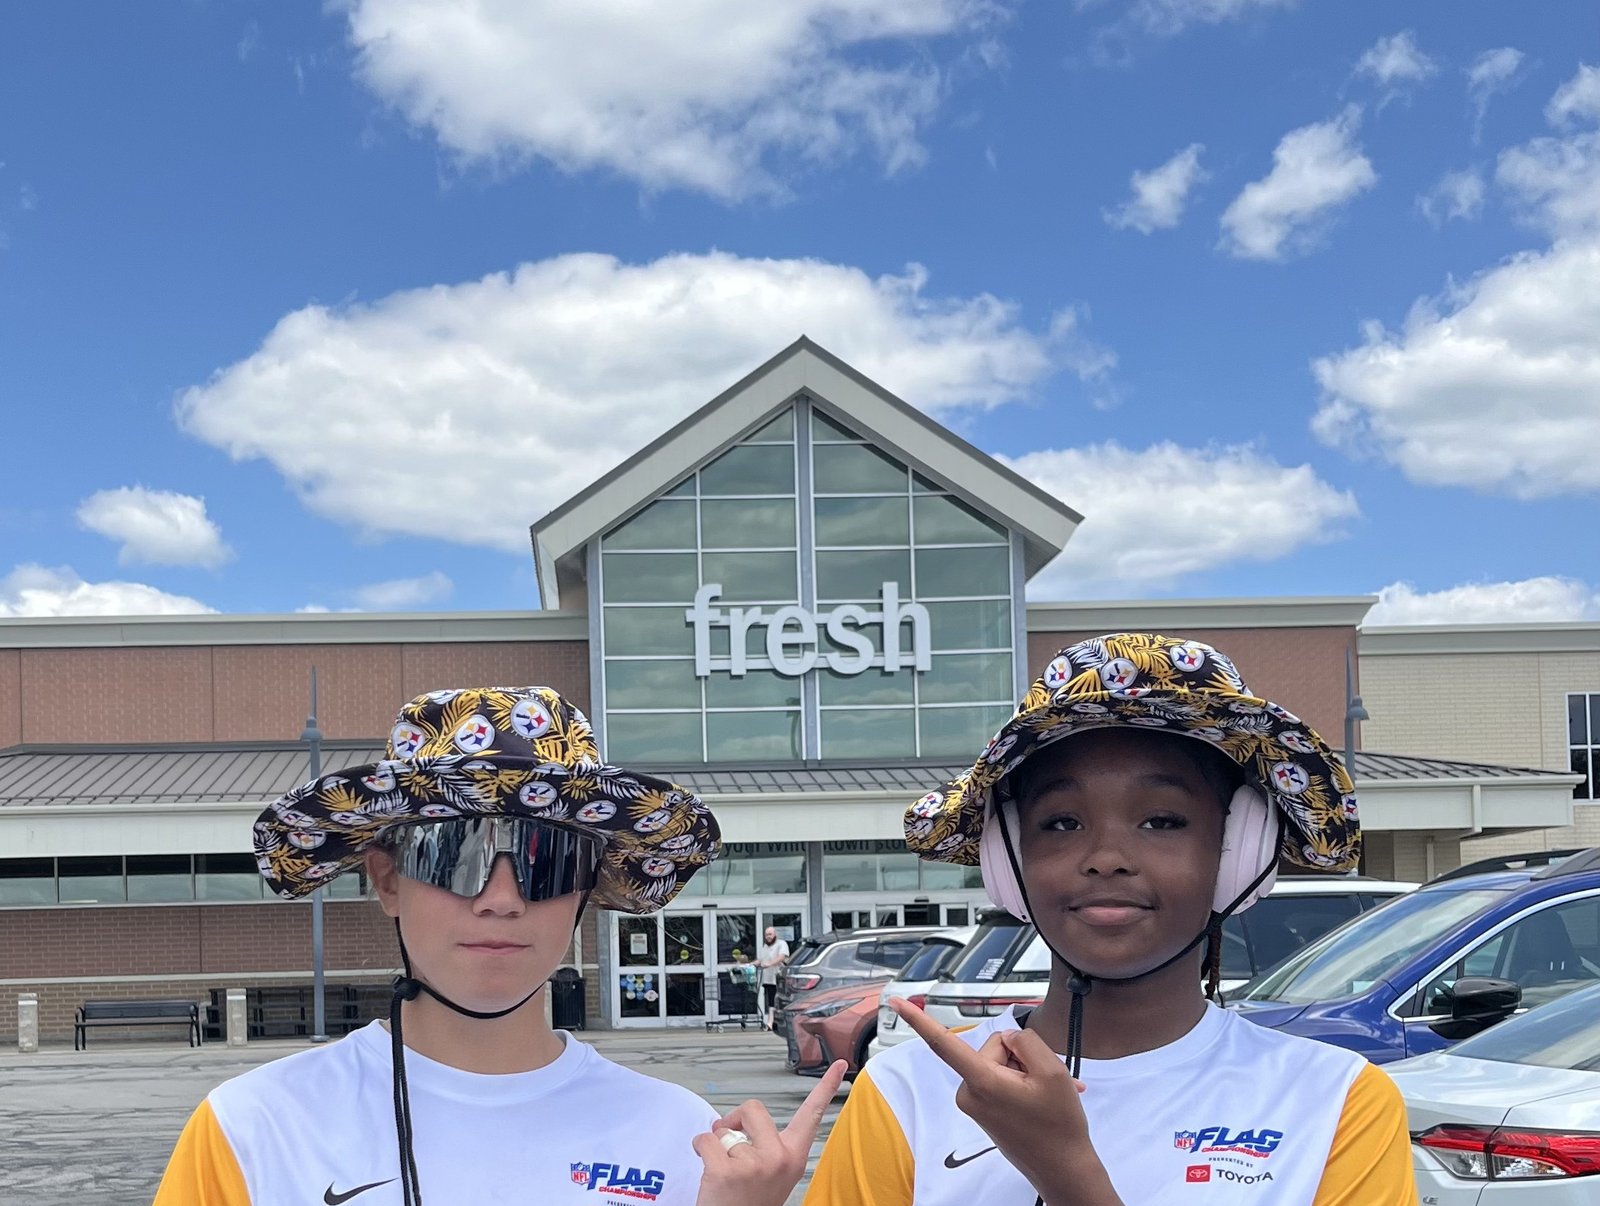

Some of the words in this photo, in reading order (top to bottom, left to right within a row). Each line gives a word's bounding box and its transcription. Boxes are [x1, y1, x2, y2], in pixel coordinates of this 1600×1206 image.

[685, 581, 932, 676] fresh
[1190, 1126, 1284, 1153] FLAG
[586, 1162, 666, 1195] FLAG
[1215, 1168, 1274, 1185] TOYOTA
[598, 1186, 657, 1201] CHAMPIONSHIPS
